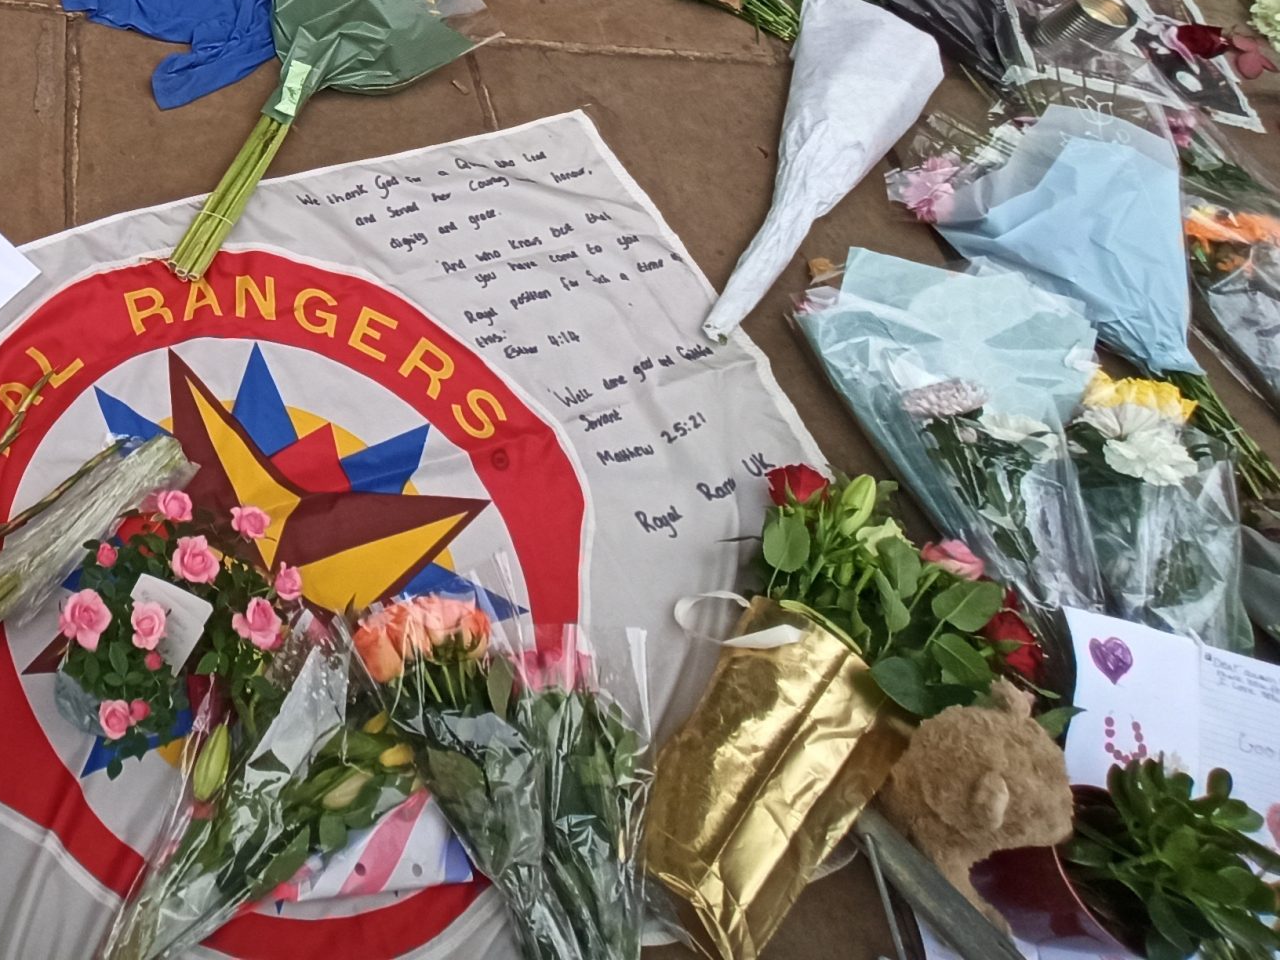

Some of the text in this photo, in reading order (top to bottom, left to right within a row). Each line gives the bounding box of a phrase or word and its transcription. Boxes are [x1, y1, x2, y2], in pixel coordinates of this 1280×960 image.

[296, 193, 321, 208] We
[375, 175, 400, 200] God
[437, 169, 450, 177] a
[355, 213, 377, 227] and
[431, 191, 452, 203] her
[438, 221, 459, 235] and
[549, 222, 575, 238] but
[474, 270, 498, 289] you
[507, 259, 539, 272] have
[585, 242, 604, 255] to
[636, 257, 665, 273] time
[547, 329, 581, 347] 4:14
[123, 274, 508, 440] RANGERS
[660, 411, 708, 444] 25:21
[633, 504, 684, 539] Royal
[741, 451, 777, 478] UK
